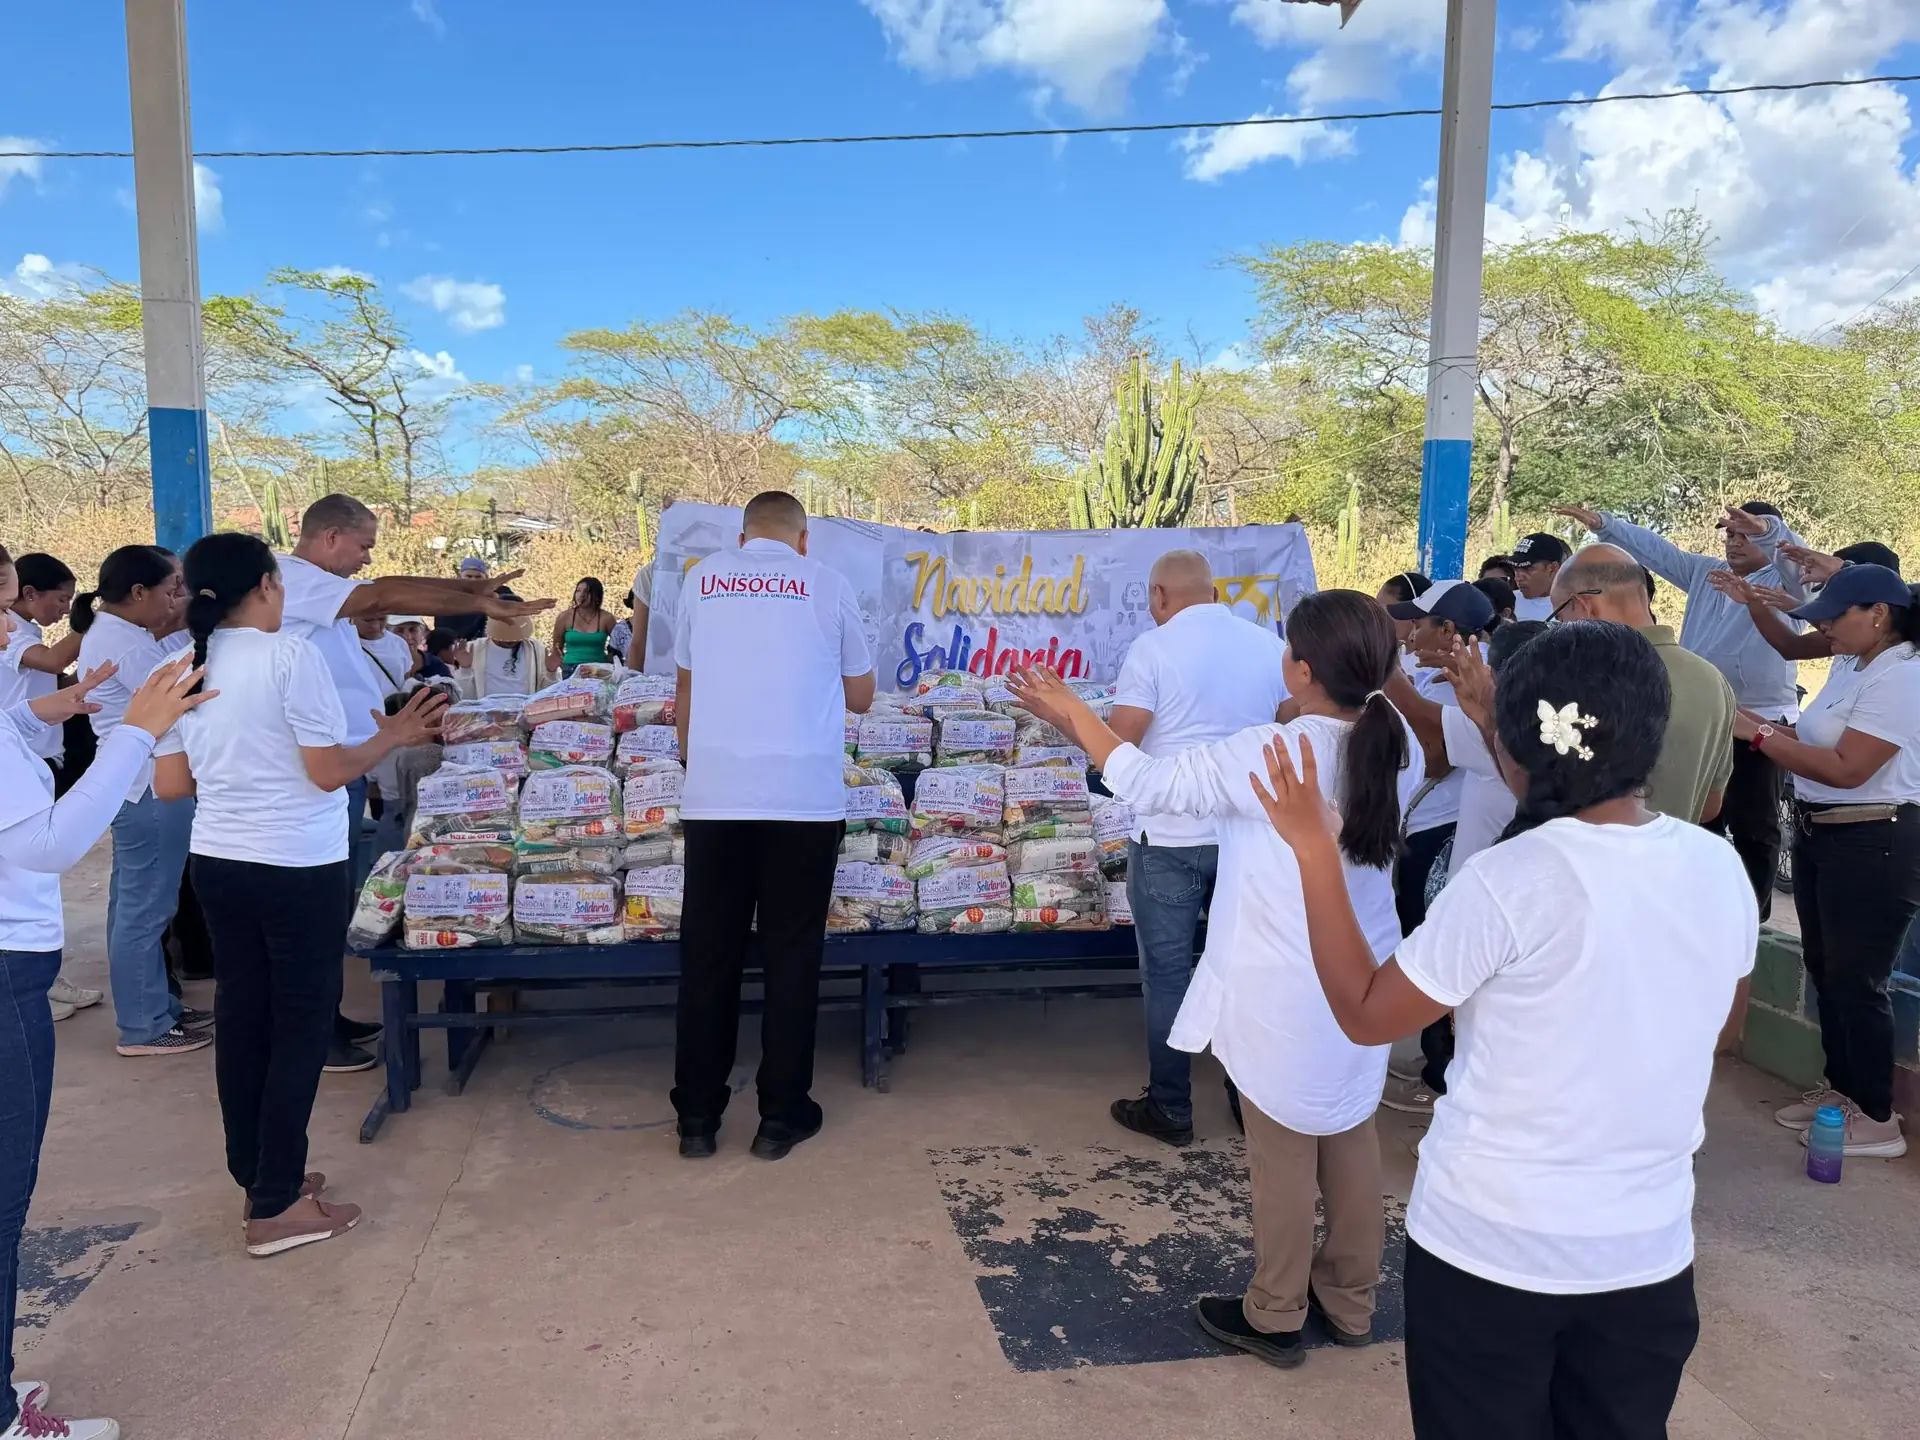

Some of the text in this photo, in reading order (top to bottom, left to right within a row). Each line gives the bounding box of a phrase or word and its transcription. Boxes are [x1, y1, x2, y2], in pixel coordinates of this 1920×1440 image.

[905, 551, 1088, 618] Navidad
[700, 593, 724, 601] CAMPAÑA
[771, 593, 807, 601] UNIVERSAL
[896, 622, 1090, 688] Solidaria
[881, 877, 911, 888] Solidaria
[976, 880, 1007, 892] Solidaria
[467, 891, 503, 904] Solidaria
[575, 901, 610, 914] Solidaria
